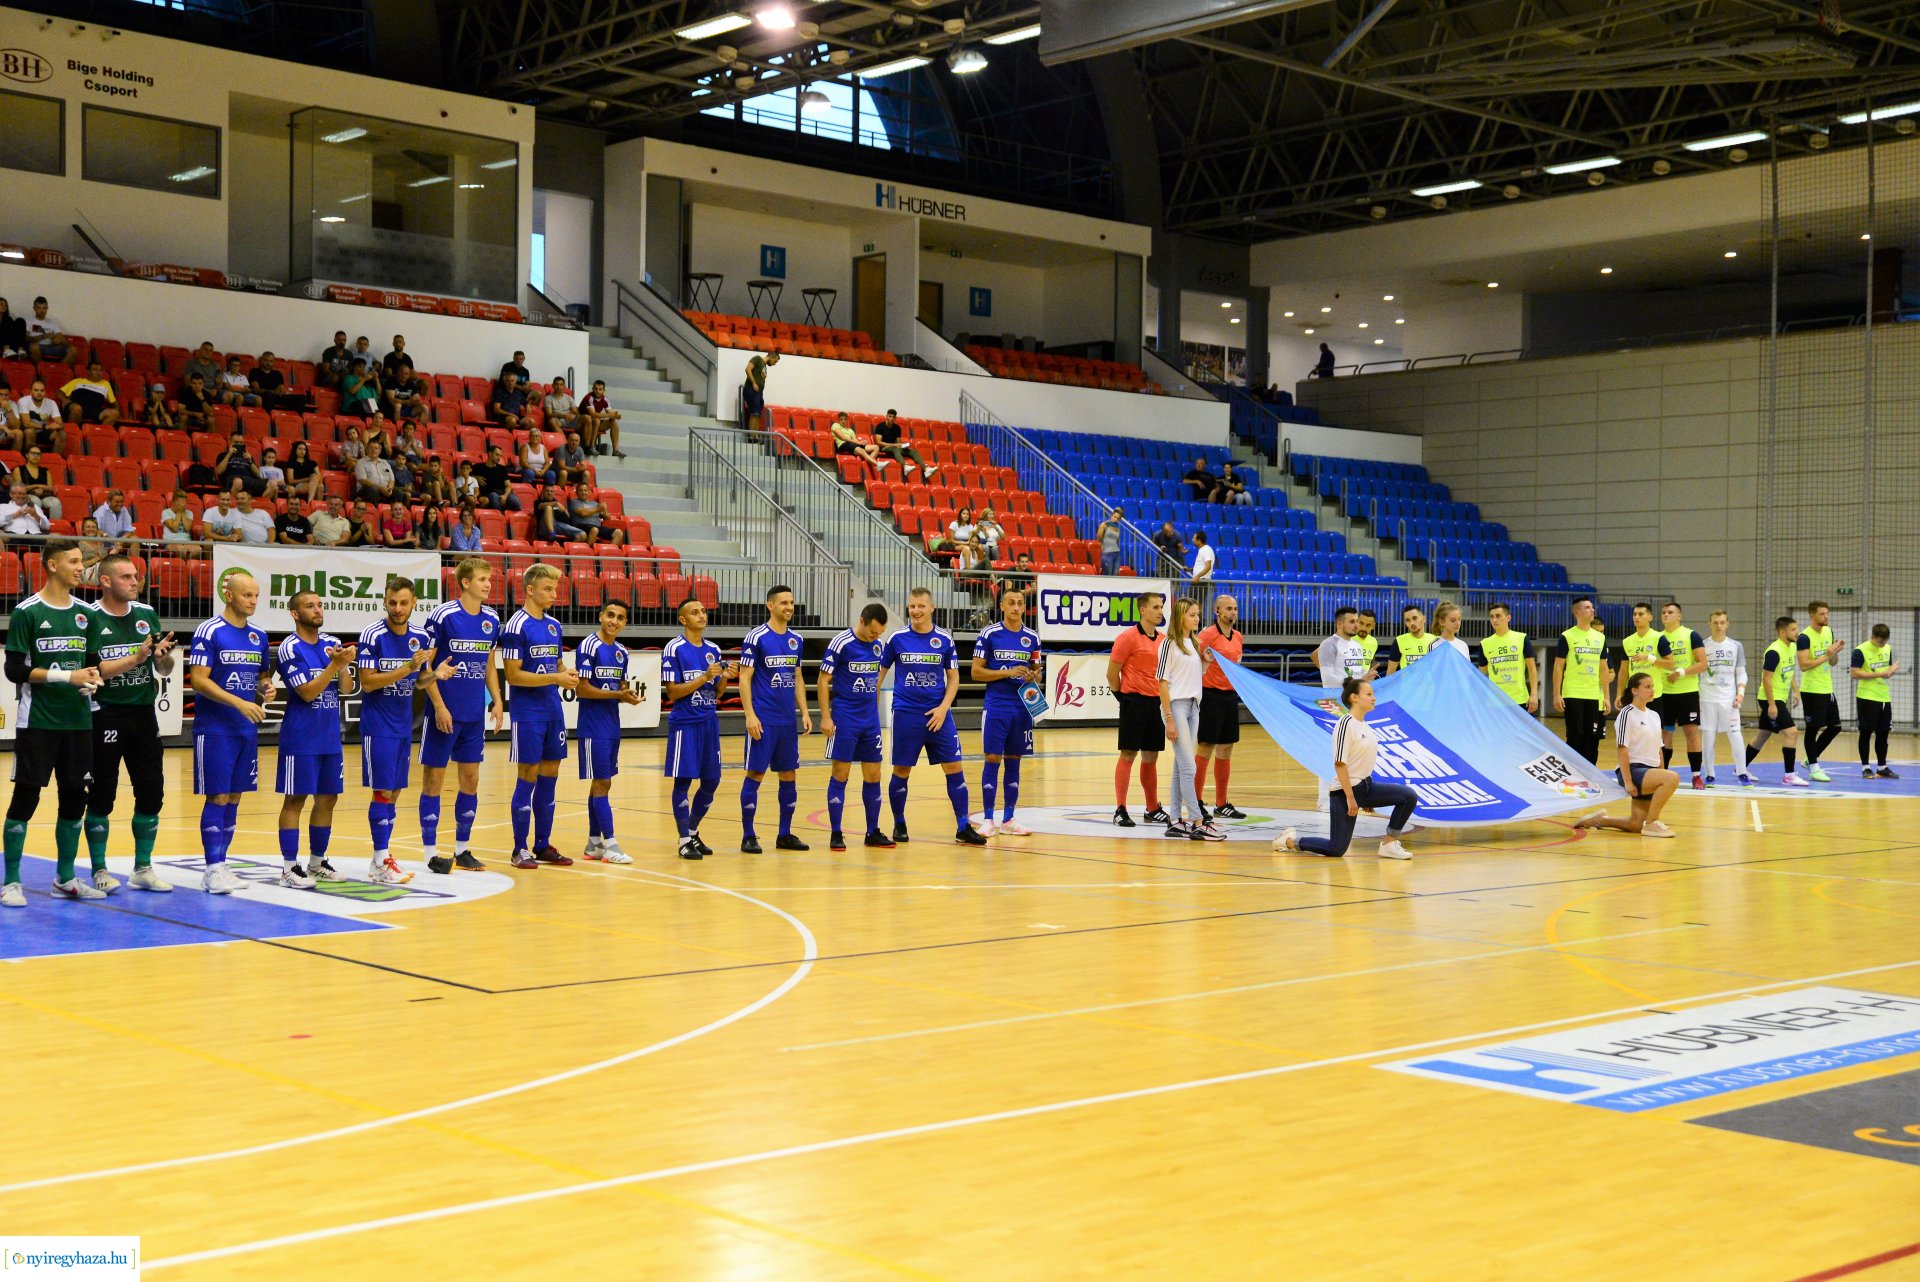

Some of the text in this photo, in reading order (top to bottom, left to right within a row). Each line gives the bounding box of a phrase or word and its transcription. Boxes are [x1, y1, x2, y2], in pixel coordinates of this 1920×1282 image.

[67, 59, 154, 87] Bige Holding
[84, 79, 138, 98] Csoport
[899, 195, 966, 221] HÜBNER
[322, 600, 379, 613] abdarúgó
[1498, 645, 1508, 655] 26
[1715, 649, 1725, 658] 55
[103, 729, 118, 743] 22
[1023, 730, 1034, 743] 10
[1524, 755, 1562, 777] FAIR
[1539, 764, 1572, 785] PLAY
